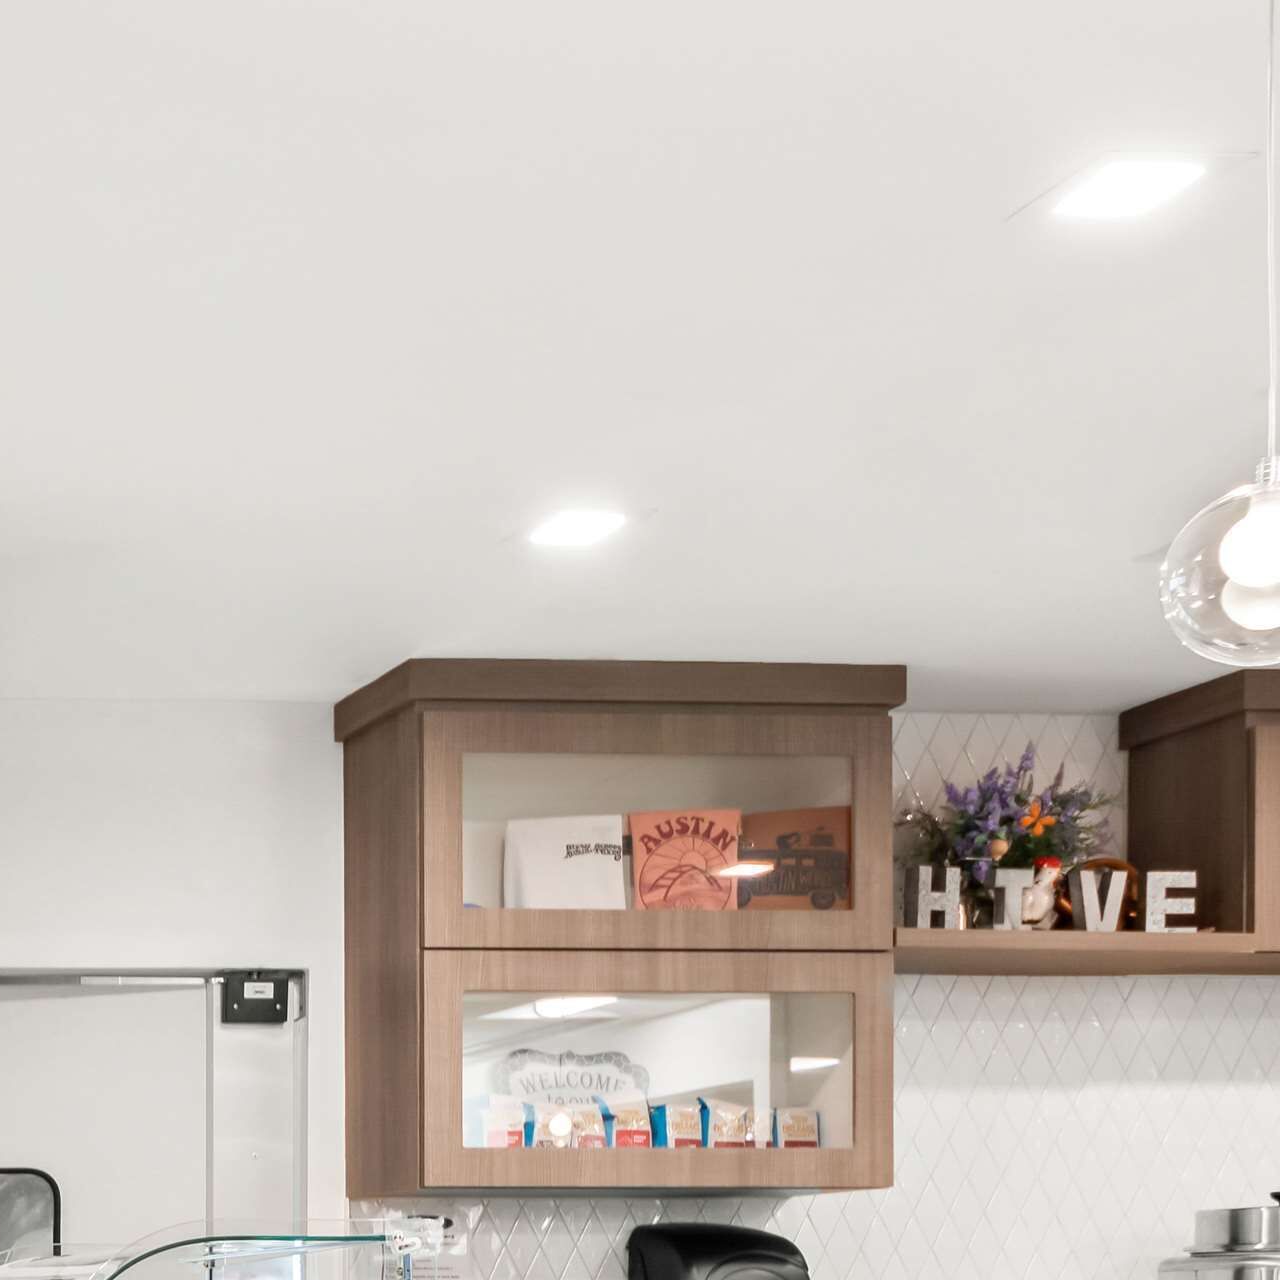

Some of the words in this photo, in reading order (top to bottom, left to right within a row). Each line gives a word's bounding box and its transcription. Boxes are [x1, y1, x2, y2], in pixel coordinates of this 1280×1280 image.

[638, 815, 737, 853] AUSTIN
[904, 865, 1198, 933] HIVE
[519, 1070, 627, 1095] WELCOME
